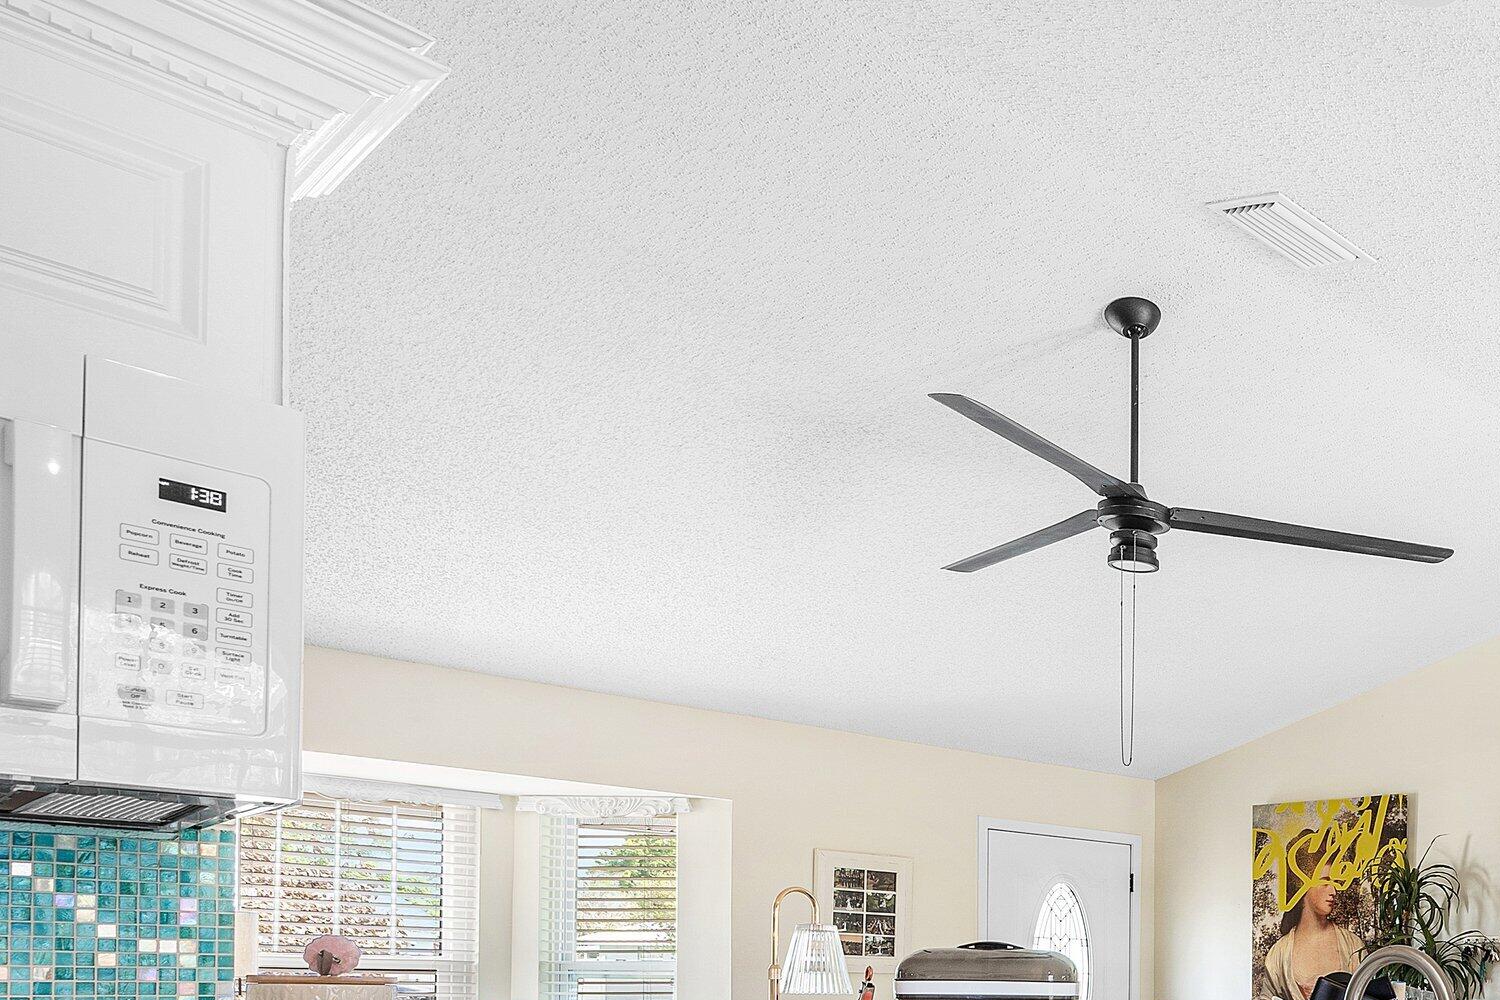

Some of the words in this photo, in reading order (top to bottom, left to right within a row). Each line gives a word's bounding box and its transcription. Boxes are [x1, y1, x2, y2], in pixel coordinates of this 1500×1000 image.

[126, 529, 153, 539] Popcorn
[151, 518, 196, 533] Convenience
[197, 528, 226, 540] Cooking
[174, 539, 203, 549] Beverage
[128, 550, 150, 559] Reheat
[225, 549, 246, 558] Potato
[139, 583, 167, 594] Express
[168, 588, 187, 597] Cook
